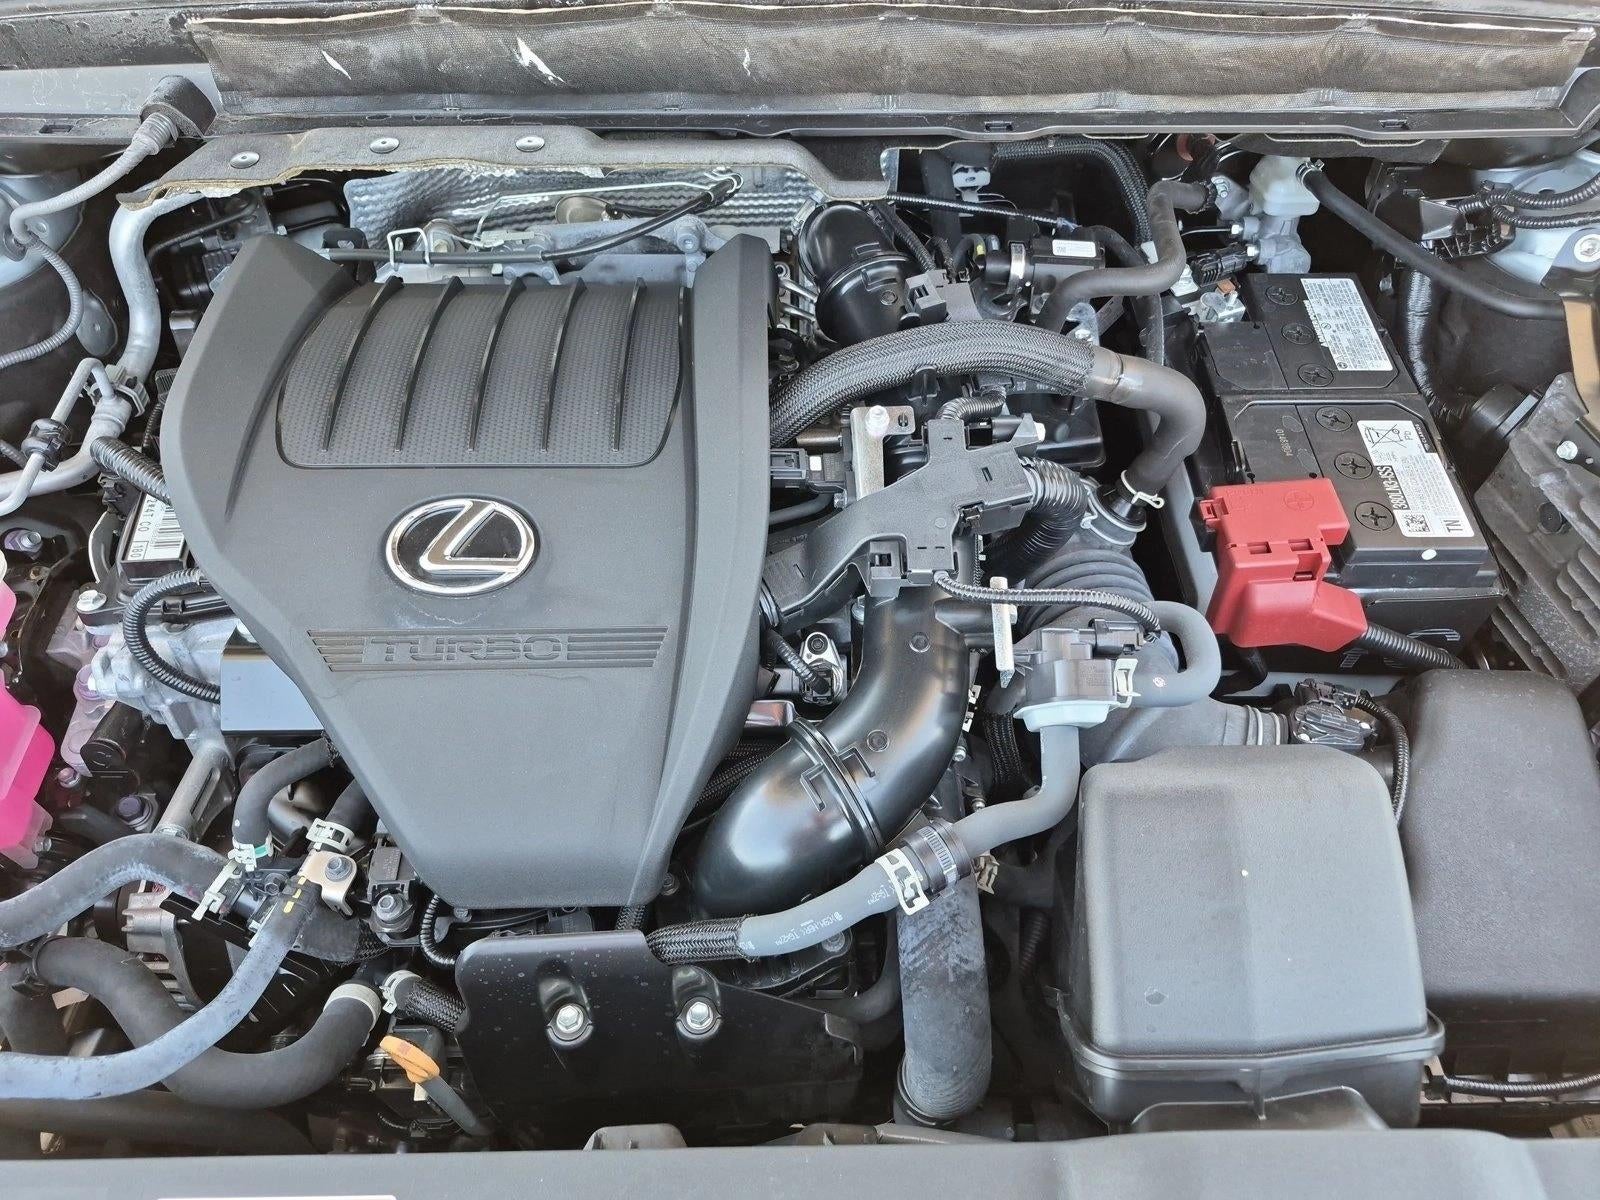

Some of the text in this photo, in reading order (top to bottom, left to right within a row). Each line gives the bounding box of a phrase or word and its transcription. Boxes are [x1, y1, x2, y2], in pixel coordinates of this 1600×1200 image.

[1404, 430, 1413, 441] Pb
[1443, 519, 1463, 533] TN
[129, 545, 143, 558] 180
[369, 635, 562, 661] TURBO
